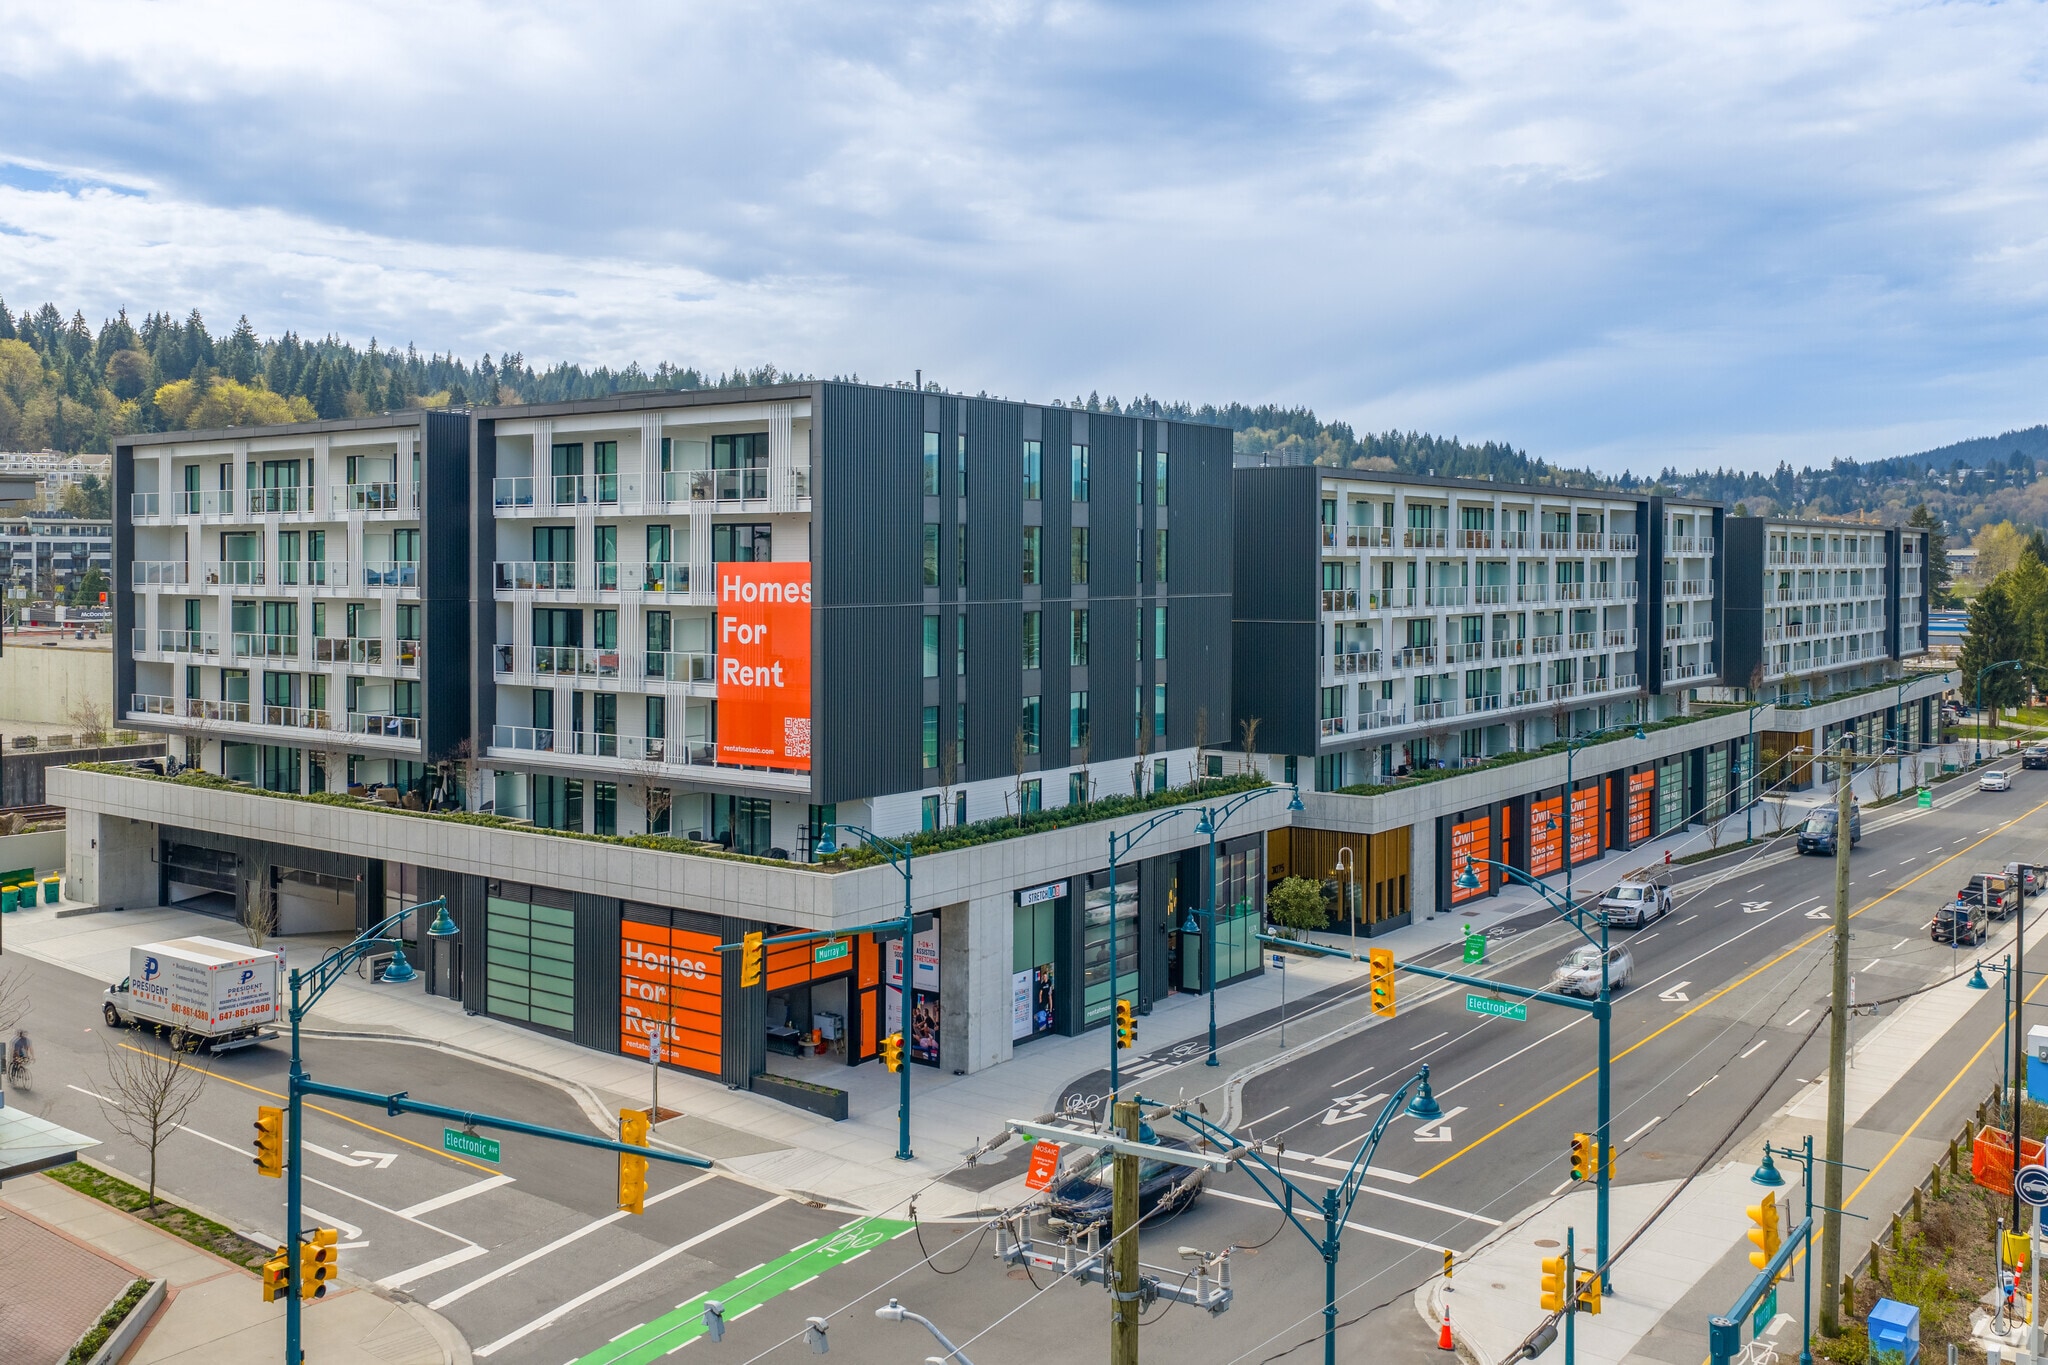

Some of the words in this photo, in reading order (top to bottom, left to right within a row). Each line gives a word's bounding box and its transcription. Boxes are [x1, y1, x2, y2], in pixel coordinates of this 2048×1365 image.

[723, 575, 811, 603] Homes
[723, 616, 767, 644] For
[723, 657, 785, 687] Rent
[723, 745, 775, 755] rentatmosaic.com
[1571, 798, 1587, 813] Own
[1532, 808, 1550, 823] Own
[1571, 814, 1584, 830] This
[1453, 830, 1474, 847] Own
[1532, 825, 1547, 842] This
[1453, 848, 1470, 866] Thi
[1531, 844, 1555, 863] Space
[625, 941, 707, 980] Homes
[819, 947, 839, 959] Murray
[913, 954, 939, 965] STRETCHING
[916, 947, 936, 957] ASSISTED
[132, 979, 168, 996] PRESIDENT
[227, 982, 263, 994] PRESIDENT
[625, 974, 666, 1002] For
[132, 989, 168, 1004] MOVERS
[171, 1002, 209, 1021] 647-861-4380
[219, 1003, 270, 1021] 647-861-4380
[1469, 998, 1512, 1015] Electronic
[1515, 1006, 1525, 1015] Ave
[625, 1005, 681, 1041] Rent
[446, 1132, 487, 1155] Electronic
[488, 1144, 498, 1155] Ave
[1035, 1144, 1057, 1156] MOSAIC
